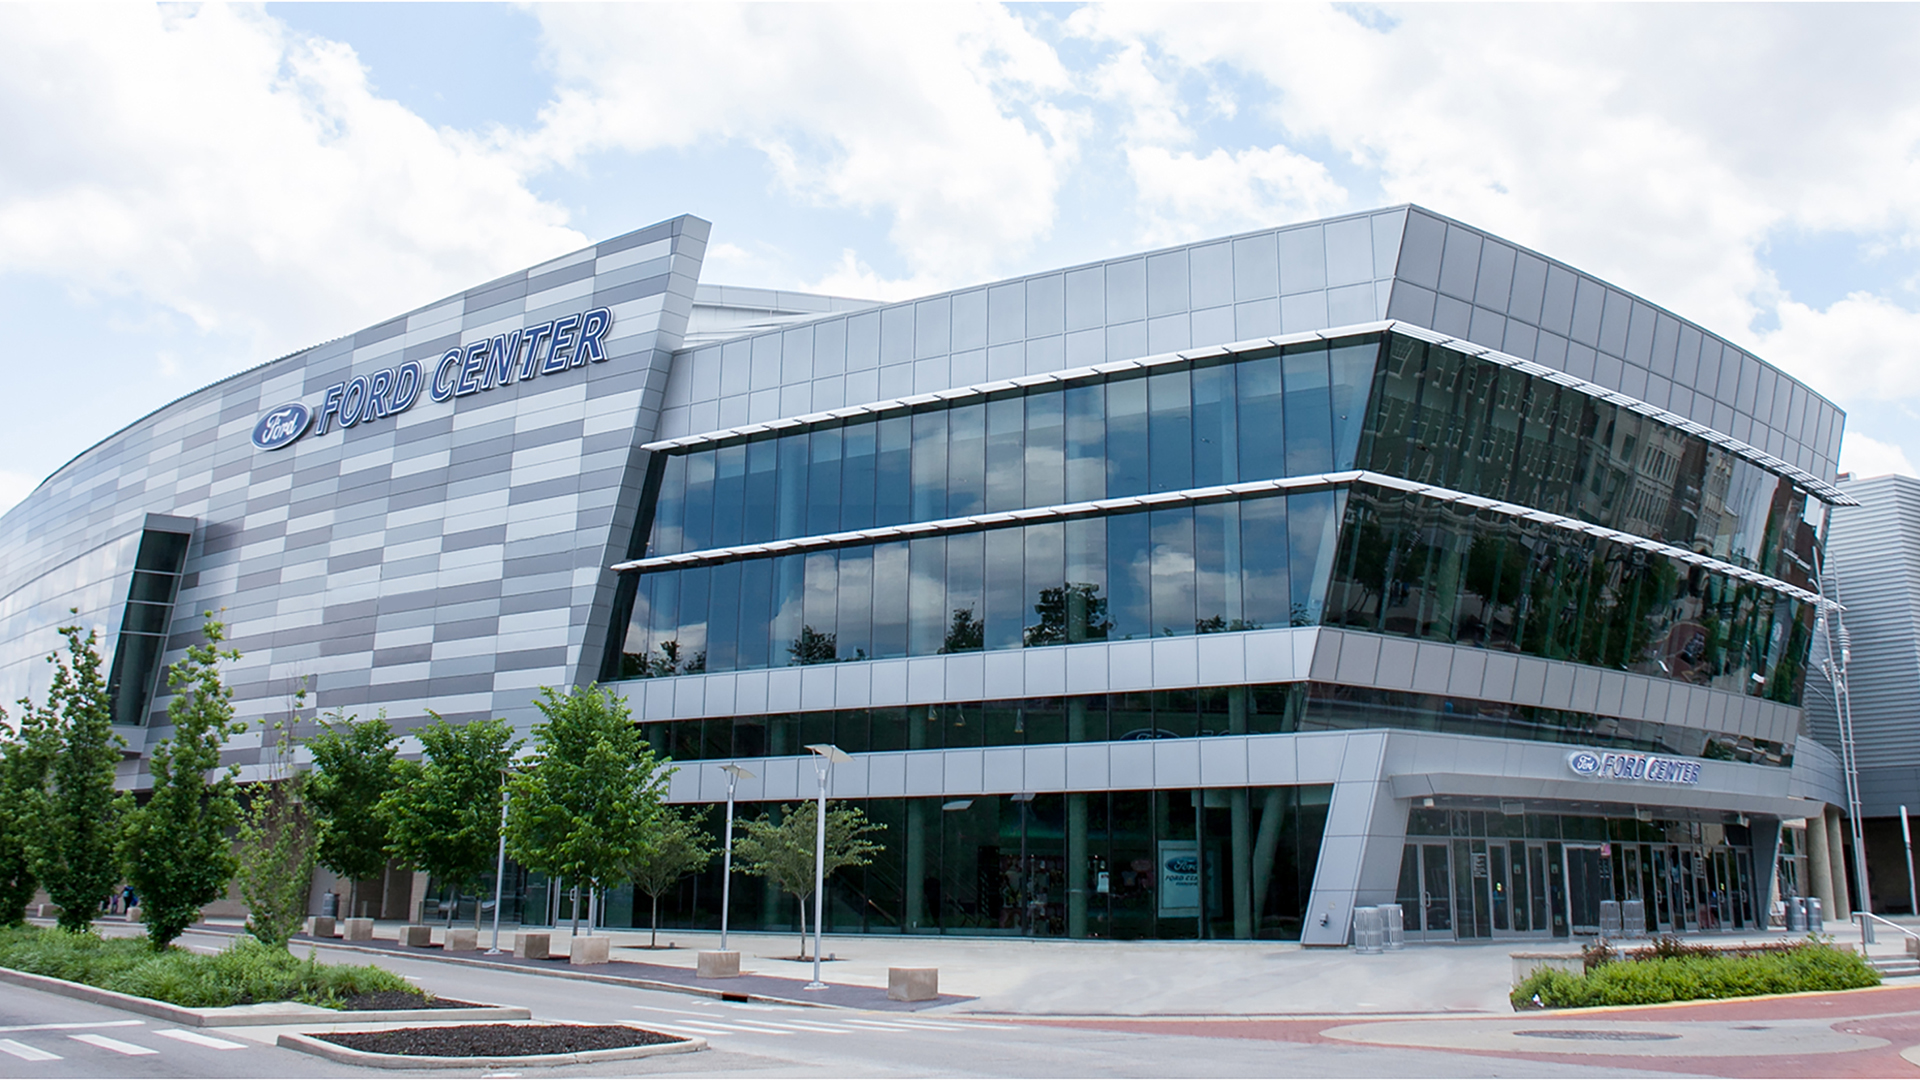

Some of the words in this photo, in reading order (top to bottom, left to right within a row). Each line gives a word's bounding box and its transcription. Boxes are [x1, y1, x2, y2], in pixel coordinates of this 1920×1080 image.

[262, 409, 299, 443] Ford
[315, 359, 424, 436] FORD
[429, 306, 613, 402] CENTER
[1577, 756, 1595, 770] Ford
[1600, 753, 1646, 778] FORD
[1646, 757, 1701, 784] CENTER
